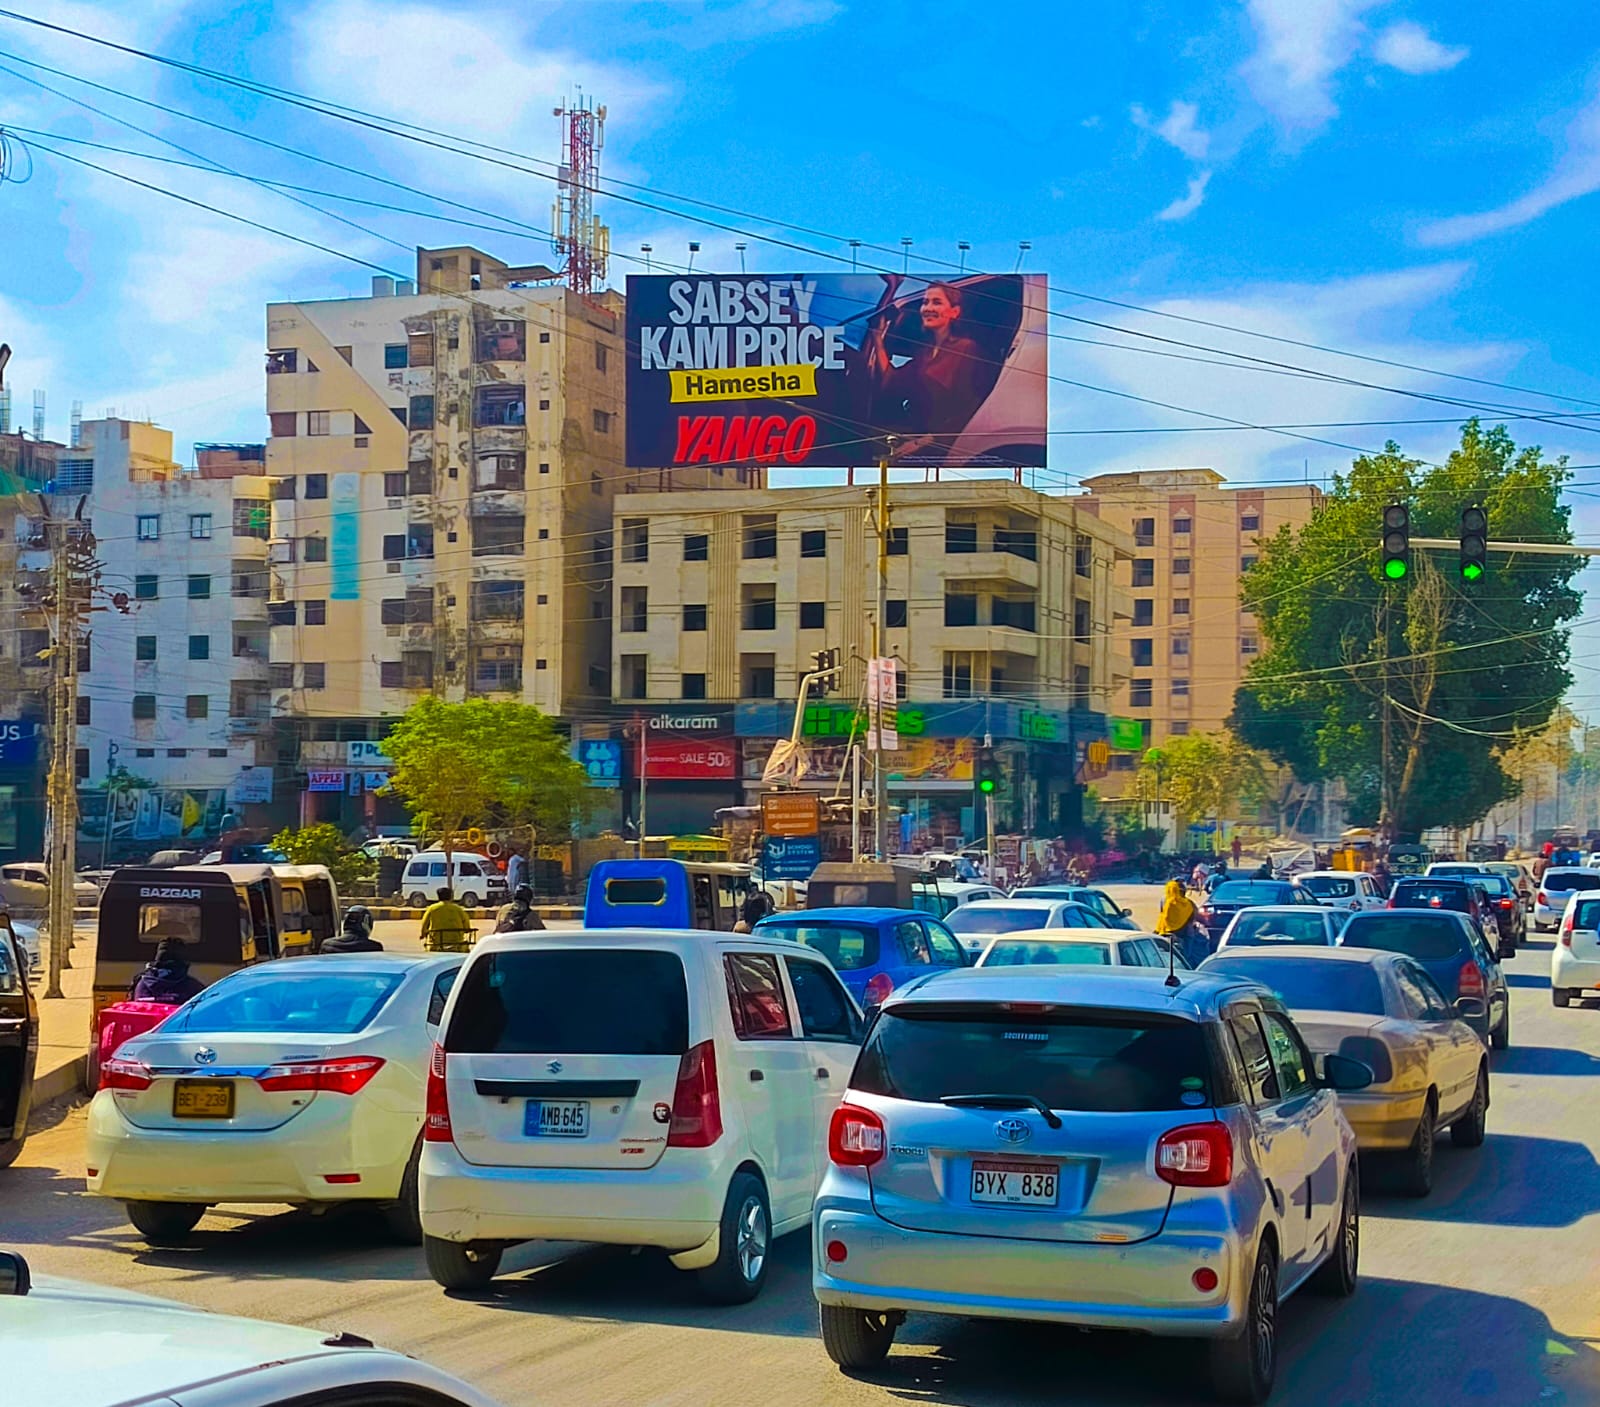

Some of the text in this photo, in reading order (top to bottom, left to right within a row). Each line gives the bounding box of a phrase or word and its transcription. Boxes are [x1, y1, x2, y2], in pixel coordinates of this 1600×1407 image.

[668, 280, 817, 324] SABSEY
[641, 325, 846, 370] KAM PRICE
[686, 371, 801, 396] Hamesha
[673, 414, 817, 464] YANGO
[679, 753, 705, 764] SALE
[311, 774, 343, 784] APPLE
[140, 887, 202, 899] SAZGAR
[974, 1172, 1055, 1198] BYX 838
